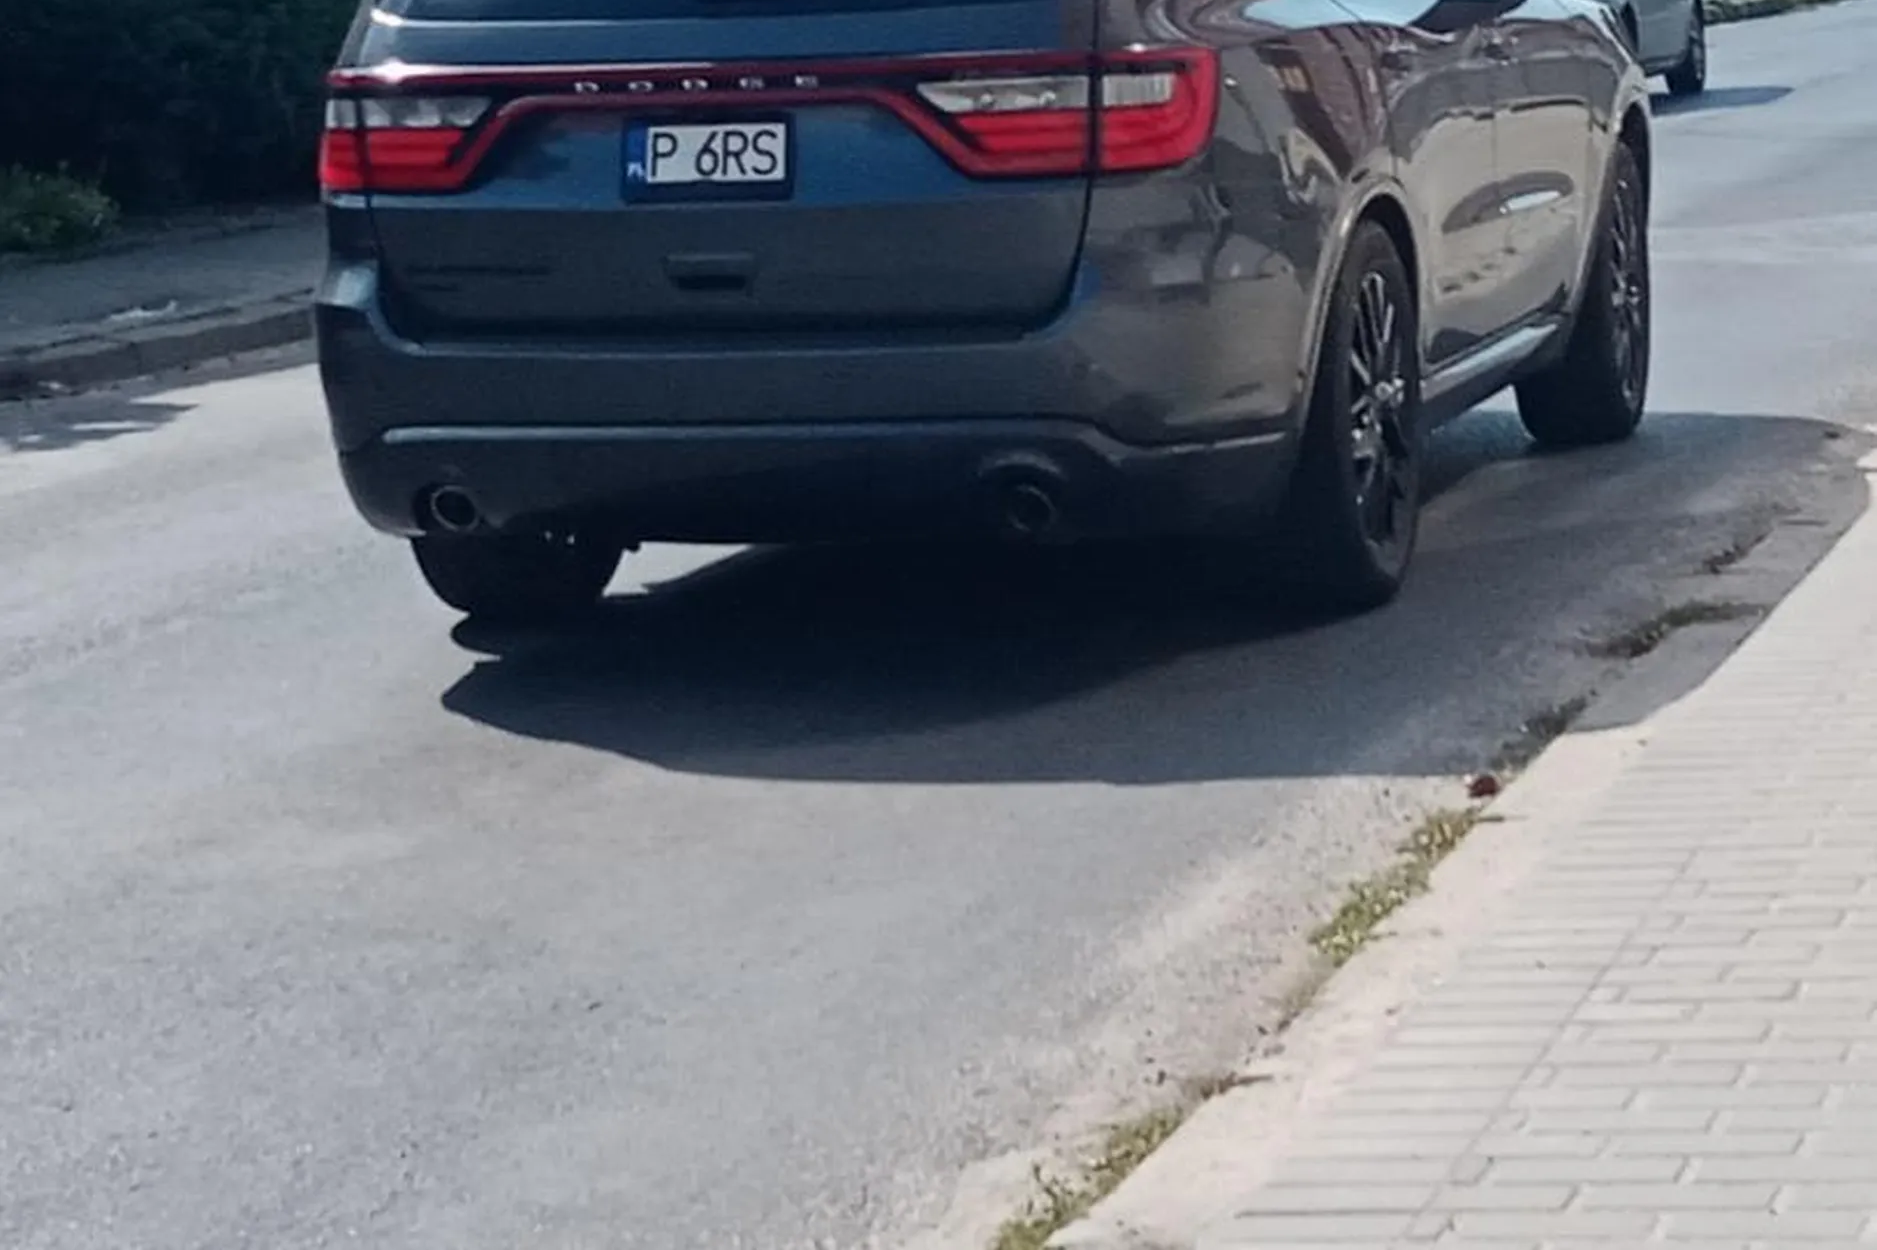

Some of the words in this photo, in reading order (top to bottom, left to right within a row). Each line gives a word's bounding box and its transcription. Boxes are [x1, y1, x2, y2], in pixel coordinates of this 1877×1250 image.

[573, 74, 819, 94] DODGE
[650, 131, 679, 178] P
[694, 128, 778, 177] 6RS
